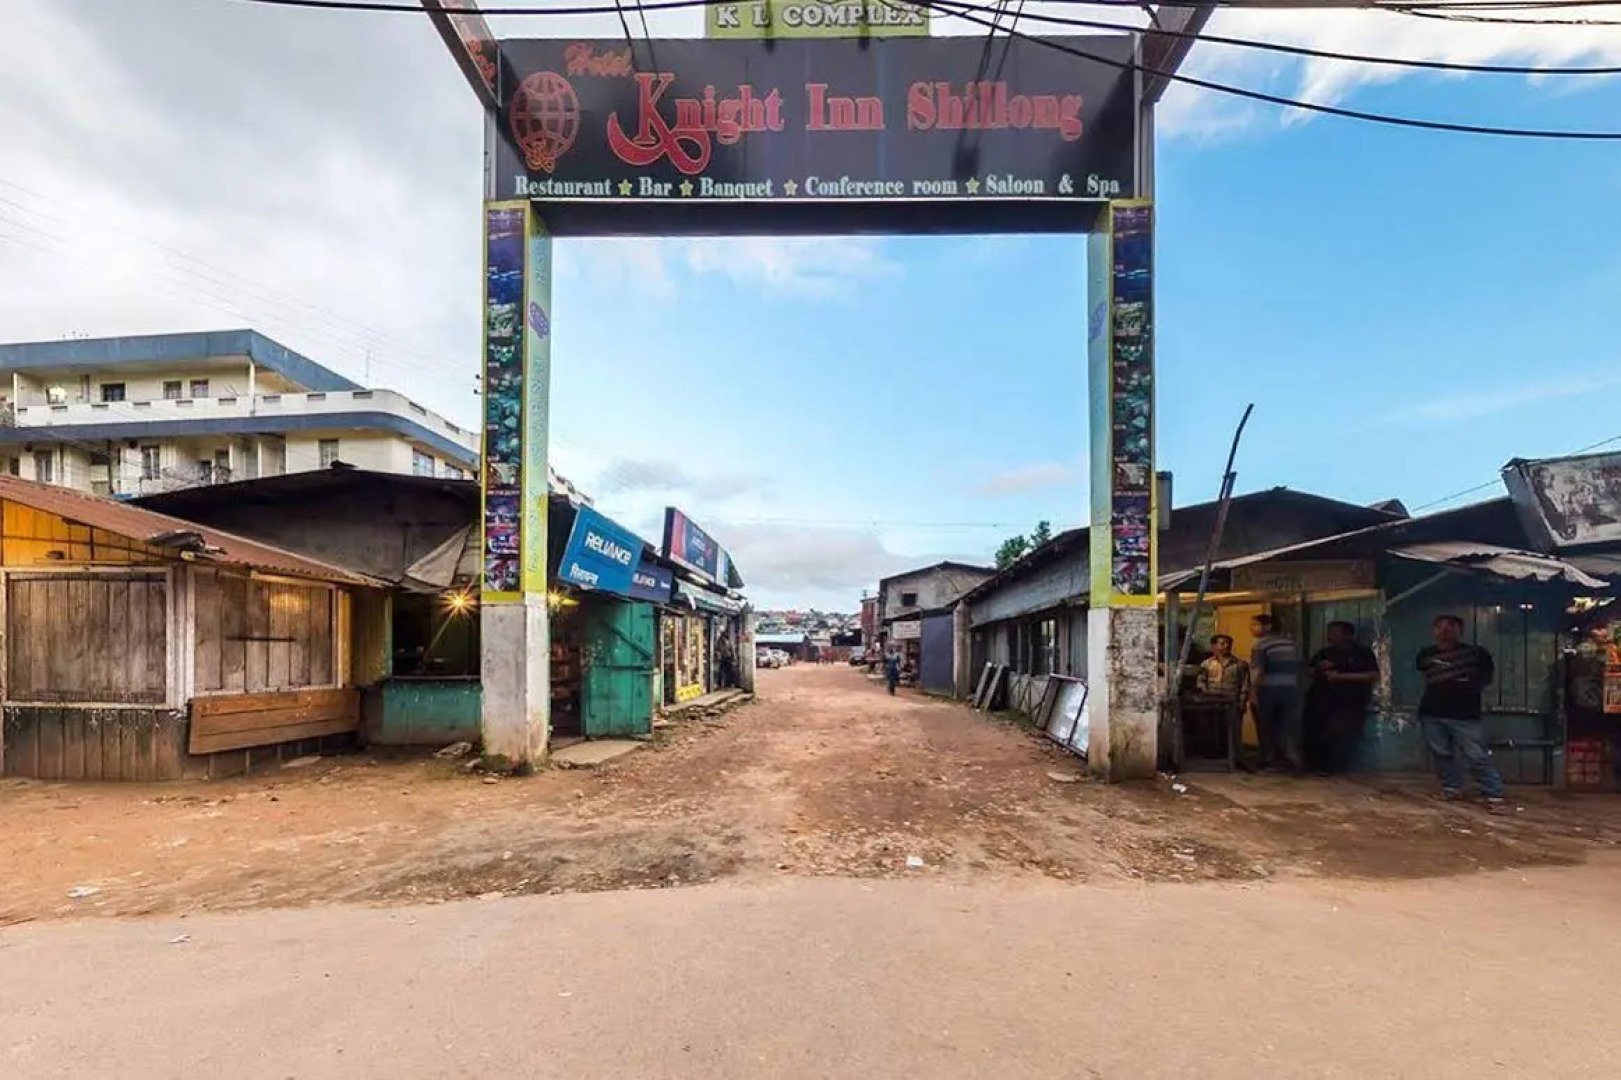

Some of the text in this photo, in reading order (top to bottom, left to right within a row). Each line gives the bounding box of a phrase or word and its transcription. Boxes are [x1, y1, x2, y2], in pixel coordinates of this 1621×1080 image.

[716, 4, 925, 27] K L COMPLEX
[607, 73, 1083, 174] Knight Inn Shillong
[515, 174, 1119, 198] Restaurant Bar Banquet Conference room Saloon & Spa
